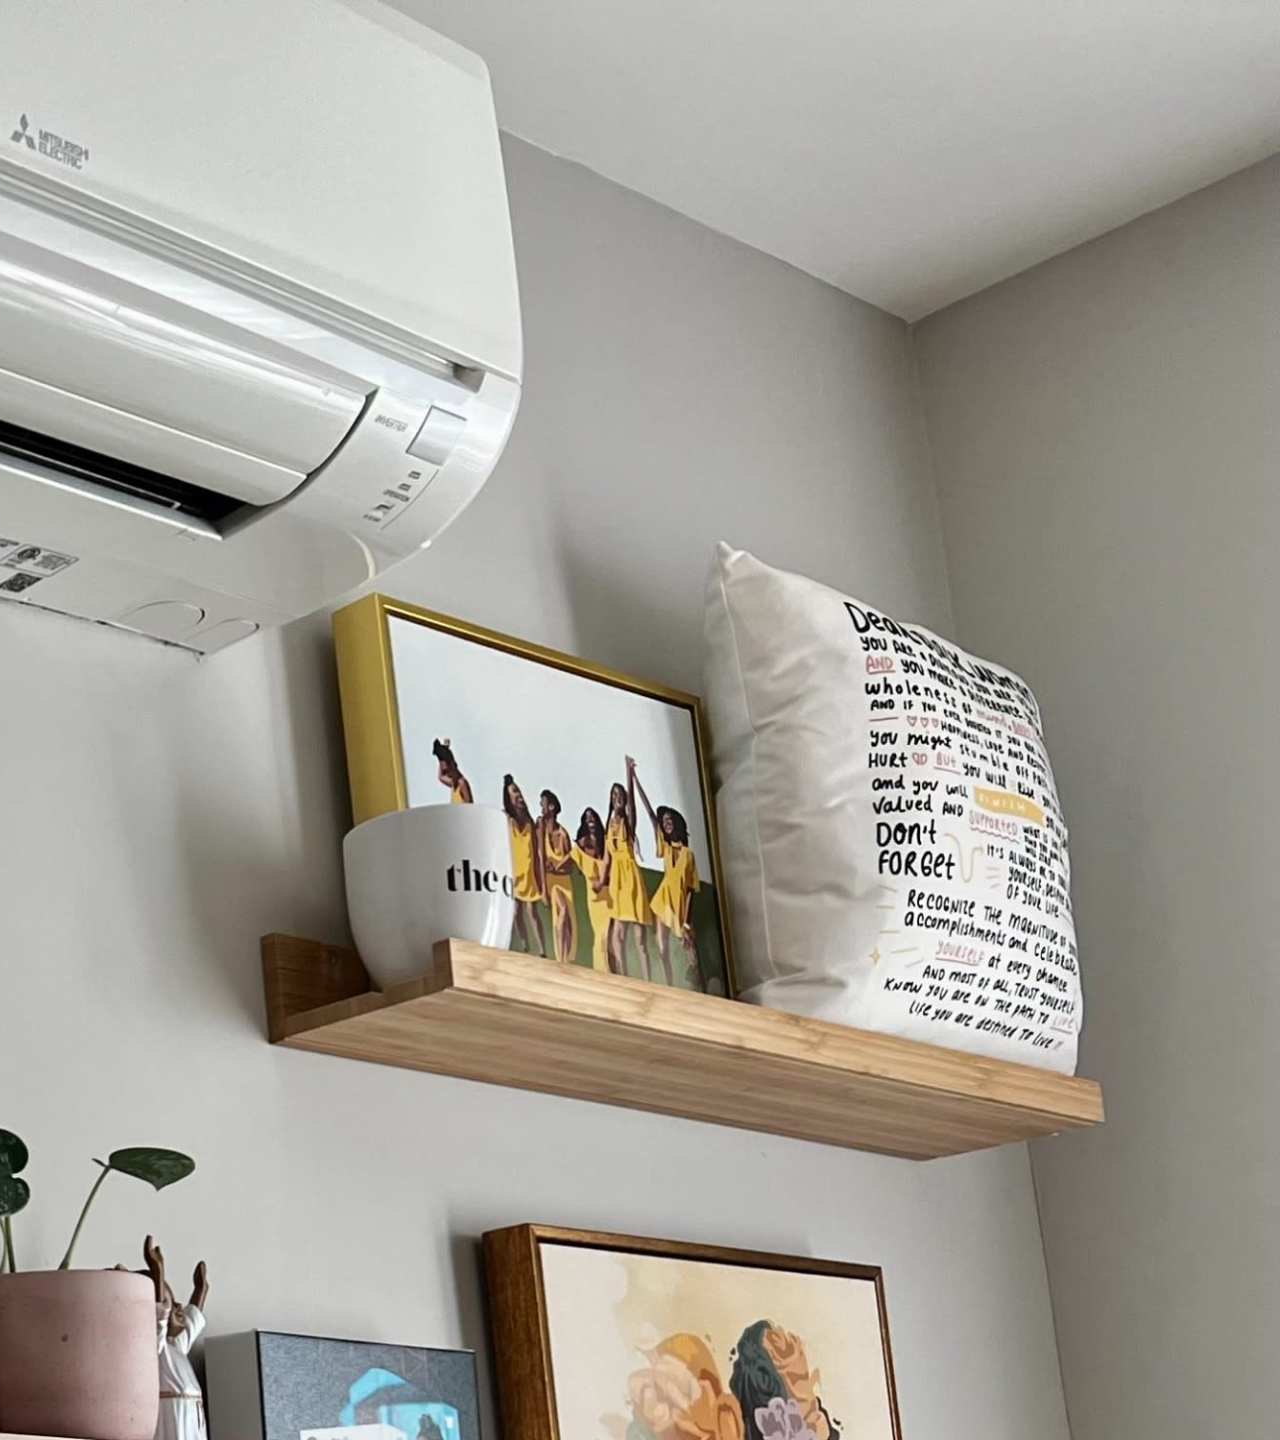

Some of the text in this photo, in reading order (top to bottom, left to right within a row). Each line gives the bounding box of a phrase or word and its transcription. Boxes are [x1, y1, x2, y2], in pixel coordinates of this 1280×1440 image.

[866, 655, 894, 672] AND
[871, 699, 914, 711] AND IF
[907, 733, 952, 749] might
[872, 774, 905, 791] and
[942, 802, 964, 817] AND
[446, 859, 498, 892] the
[988, 954, 1001, 968] at
[1006, 957, 1032, 982] every
